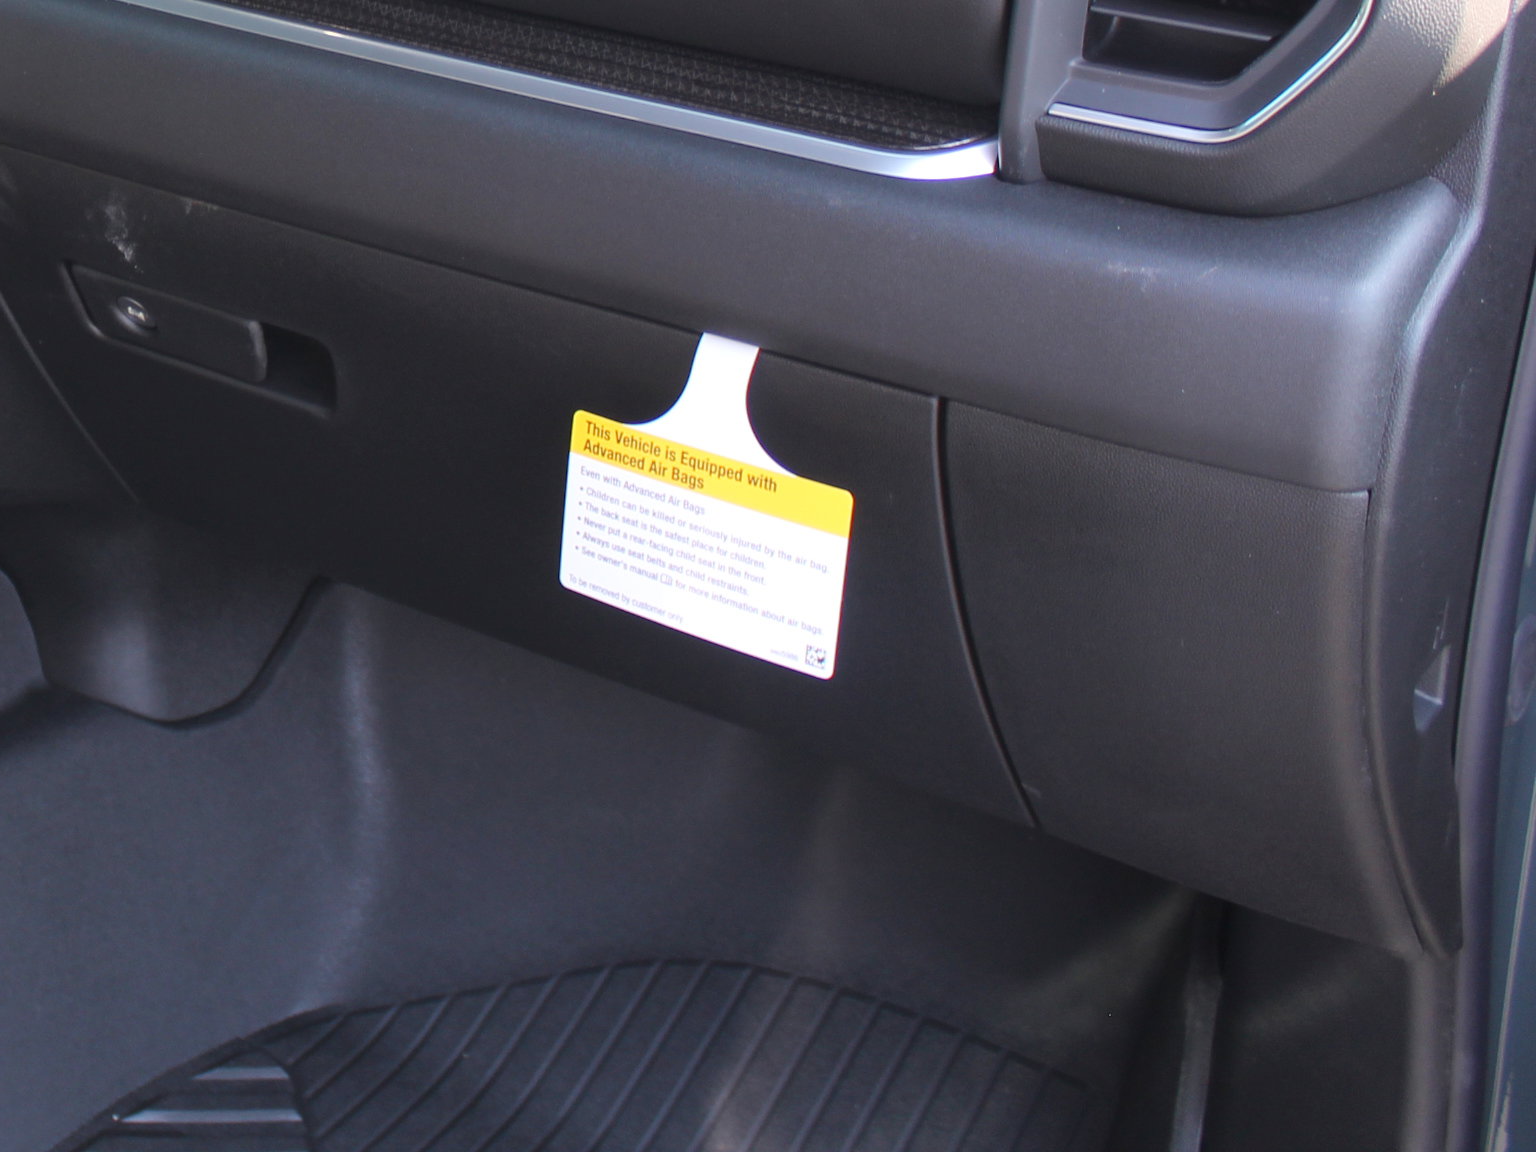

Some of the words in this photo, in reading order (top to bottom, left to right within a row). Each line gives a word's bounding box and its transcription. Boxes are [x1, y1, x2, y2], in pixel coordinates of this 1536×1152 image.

[583, 439, 645, 470] Advanced
[648, 460, 668, 477] Air
[671, 467, 704, 490] Bags
[586, 420, 611, 441] This
[615, 430, 661, 457] Vehicle
[665, 446, 676, 462] is
[680, 451, 742, 482] Equipped
[747, 474, 777, 493] with
[580, 465, 600, 480] Even
[603, 476, 621, 487] with
[623, 481, 666, 502] Advanced
[668, 495, 681, 506] Air
[683, 499, 705, 515] Bags
[583, 516, 606, 530] Never
[607, 526, 621, 537] put
[629, 534, 674, 557] rear-facing
[675, 550, 696, 562] child
[698, 557, 715, 568] seat
[717, 563, 726, 572] in
[728, 566, 742, 577] the
[585, 501, 599, 514] The
[600, 507, 619, 520] back
[622, 516, 639, 527] seat
[640, 522, 648, 530] is
[649, 524, 663, 535] the
[664, 530, 689, 544] safest
[691, 539, 714, 552] place
[716, 546, 728, 557] for
[586, 487, 620, 505] Children
[622, 501, 637, 511] can
[639, 505, 650, 516] be
[651, 510, 675, 524] killed
[677, 519, 686, 528] or
[689, 523, 728, 543] seriously
[730, 535, 762, 552] injured
[764, 545, 775, 558] by
[777, 550, 792, 561] the
[794, 556, 807, 565] air
[582, 531, 610, 548] Always
[611, 544, 625, 553] use
[628, 549, 645, 560] seat
[646, 554, 666, 568] belts
[668, 563, 684, 574] and
[685, 569, 705, 581] child
[569, 573, 577, 584] To
[578, 578, 587, 588] be
[588, 583, 620, 600] removed
[621, 593, 630, 605] by
[631, 599, 666, 615] customer
[581, 546, 596, 558] See
[597, 553, 628, 570] owner's
[629, 565, 658, 581] manual
[675, 579, 686, 589] for
[688, 585, 709, 598] more
[711, 593, 758, 614] information
[761, 610, 785, 623] about
[787, 618, 798, 626] air
